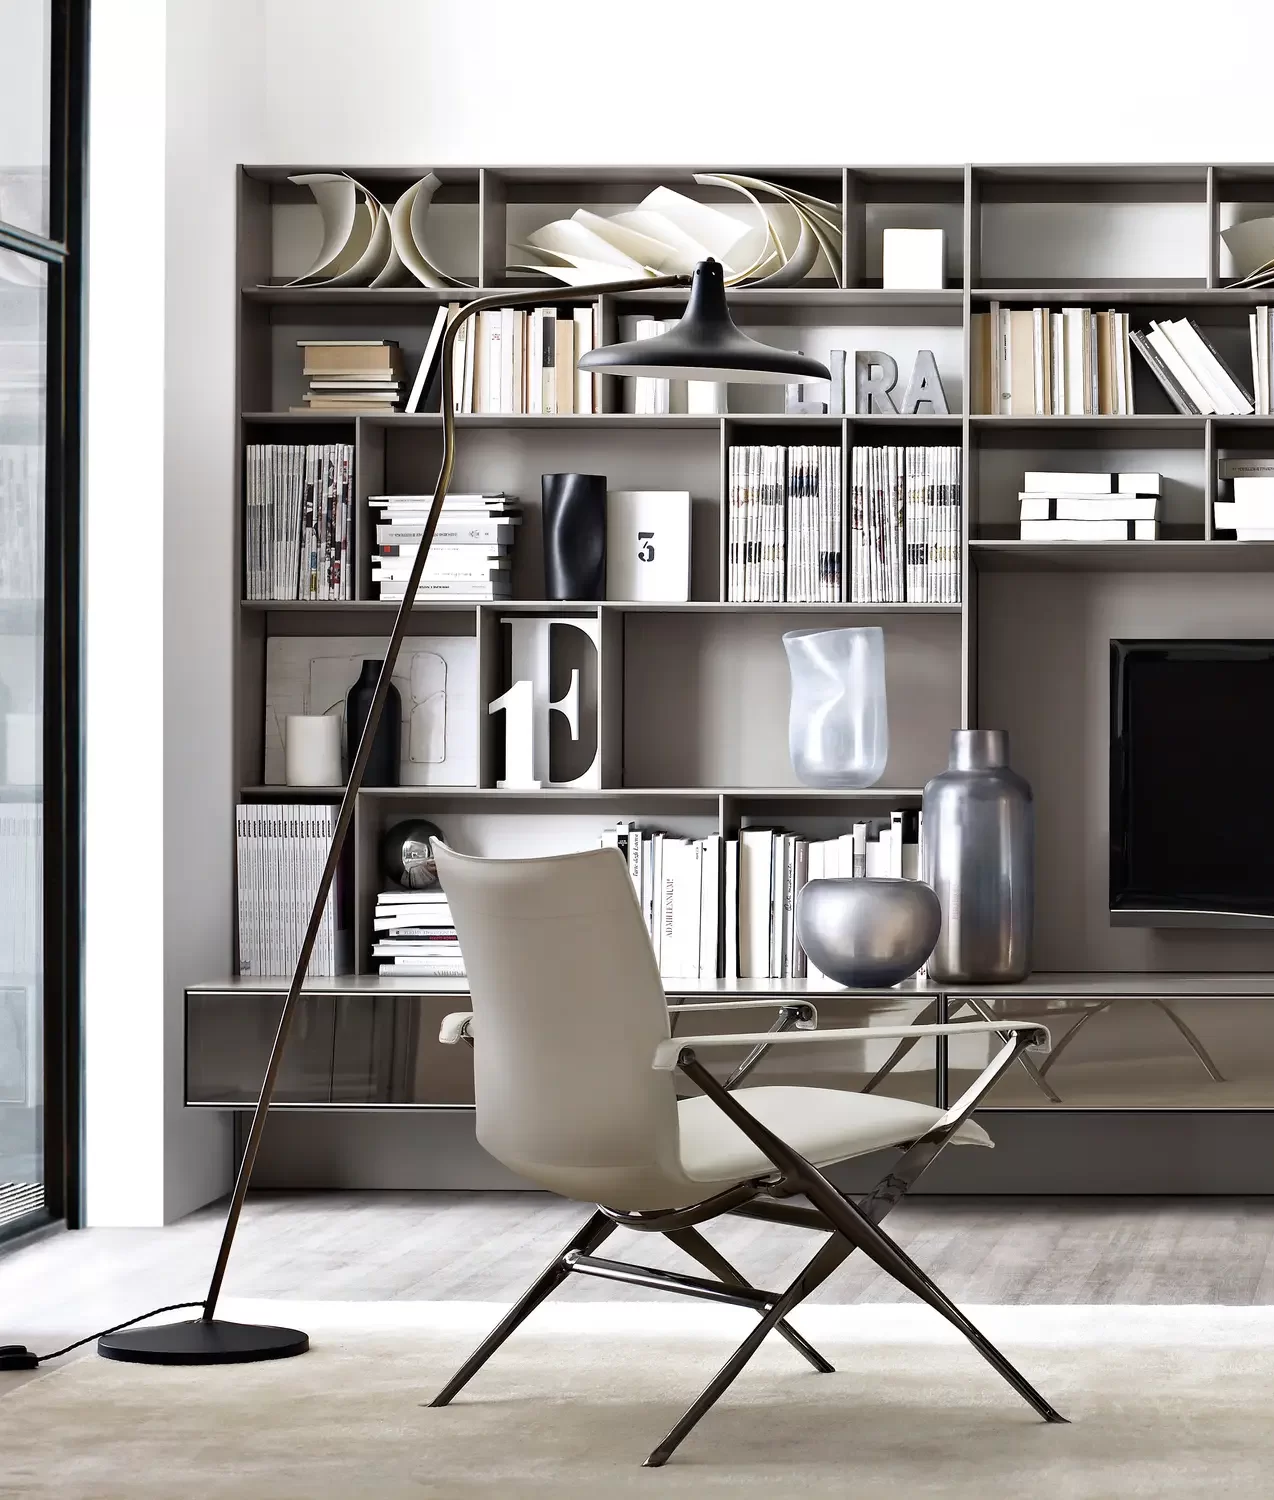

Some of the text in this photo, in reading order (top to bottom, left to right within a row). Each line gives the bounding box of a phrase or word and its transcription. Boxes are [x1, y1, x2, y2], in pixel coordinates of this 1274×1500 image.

[785, 350, 950, 414] LIRA
[637, 532, 656, 562] 3
[489, 681, 541, 789] 1
[501, 618, 601, 789] E
